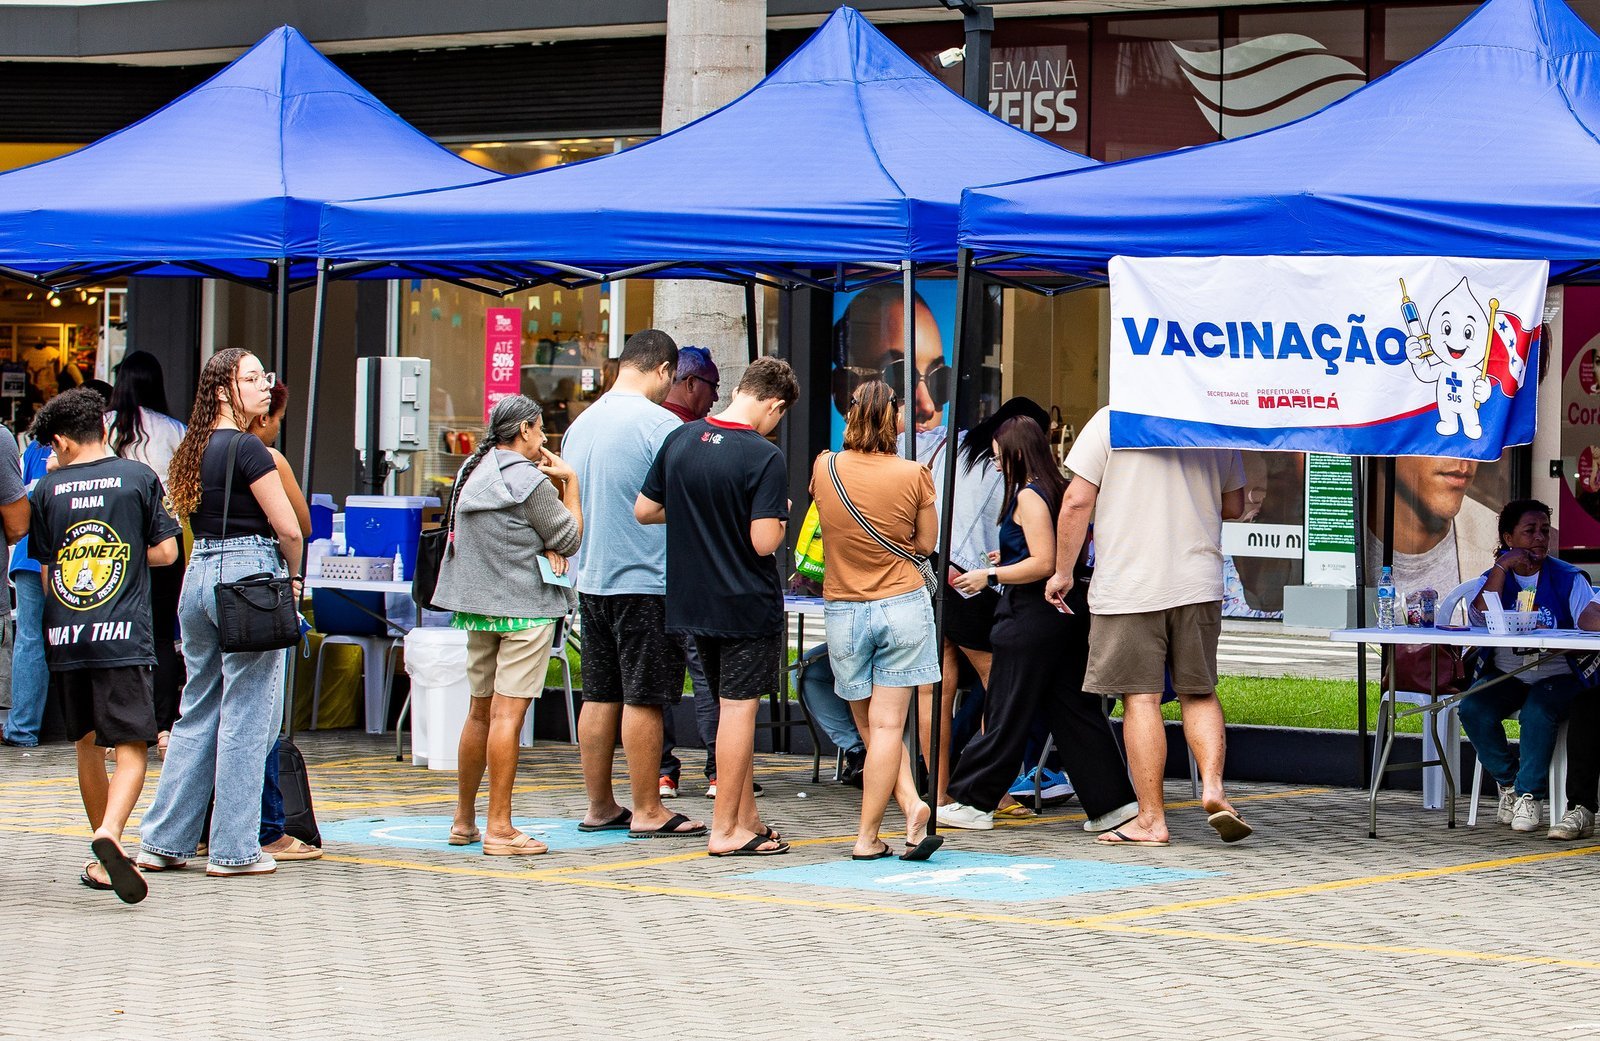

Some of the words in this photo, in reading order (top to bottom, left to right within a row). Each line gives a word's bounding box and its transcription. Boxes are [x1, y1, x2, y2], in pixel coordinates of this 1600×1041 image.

[494, 340, 513, 353] ATÉ
[1121, 313, 1407, 375] VACINAÇÃO
[492, 353, 515, 367] 50%
[492, 367, 513, 382] OFF
[1258, 393, 1340, 410] MARICÁ
[1447, 393, 1462, 403] SUS
[54, 477, 122, 496] INSTRUTORA
[71, 495, 104, 510] DIANA
[72, 523, 104, 538] HONRA
[54, 570, 80, 605] DISCIPLINA
[97, 562, 122, 600] RESPEITO
[91, 621, 132, 642] THAI
